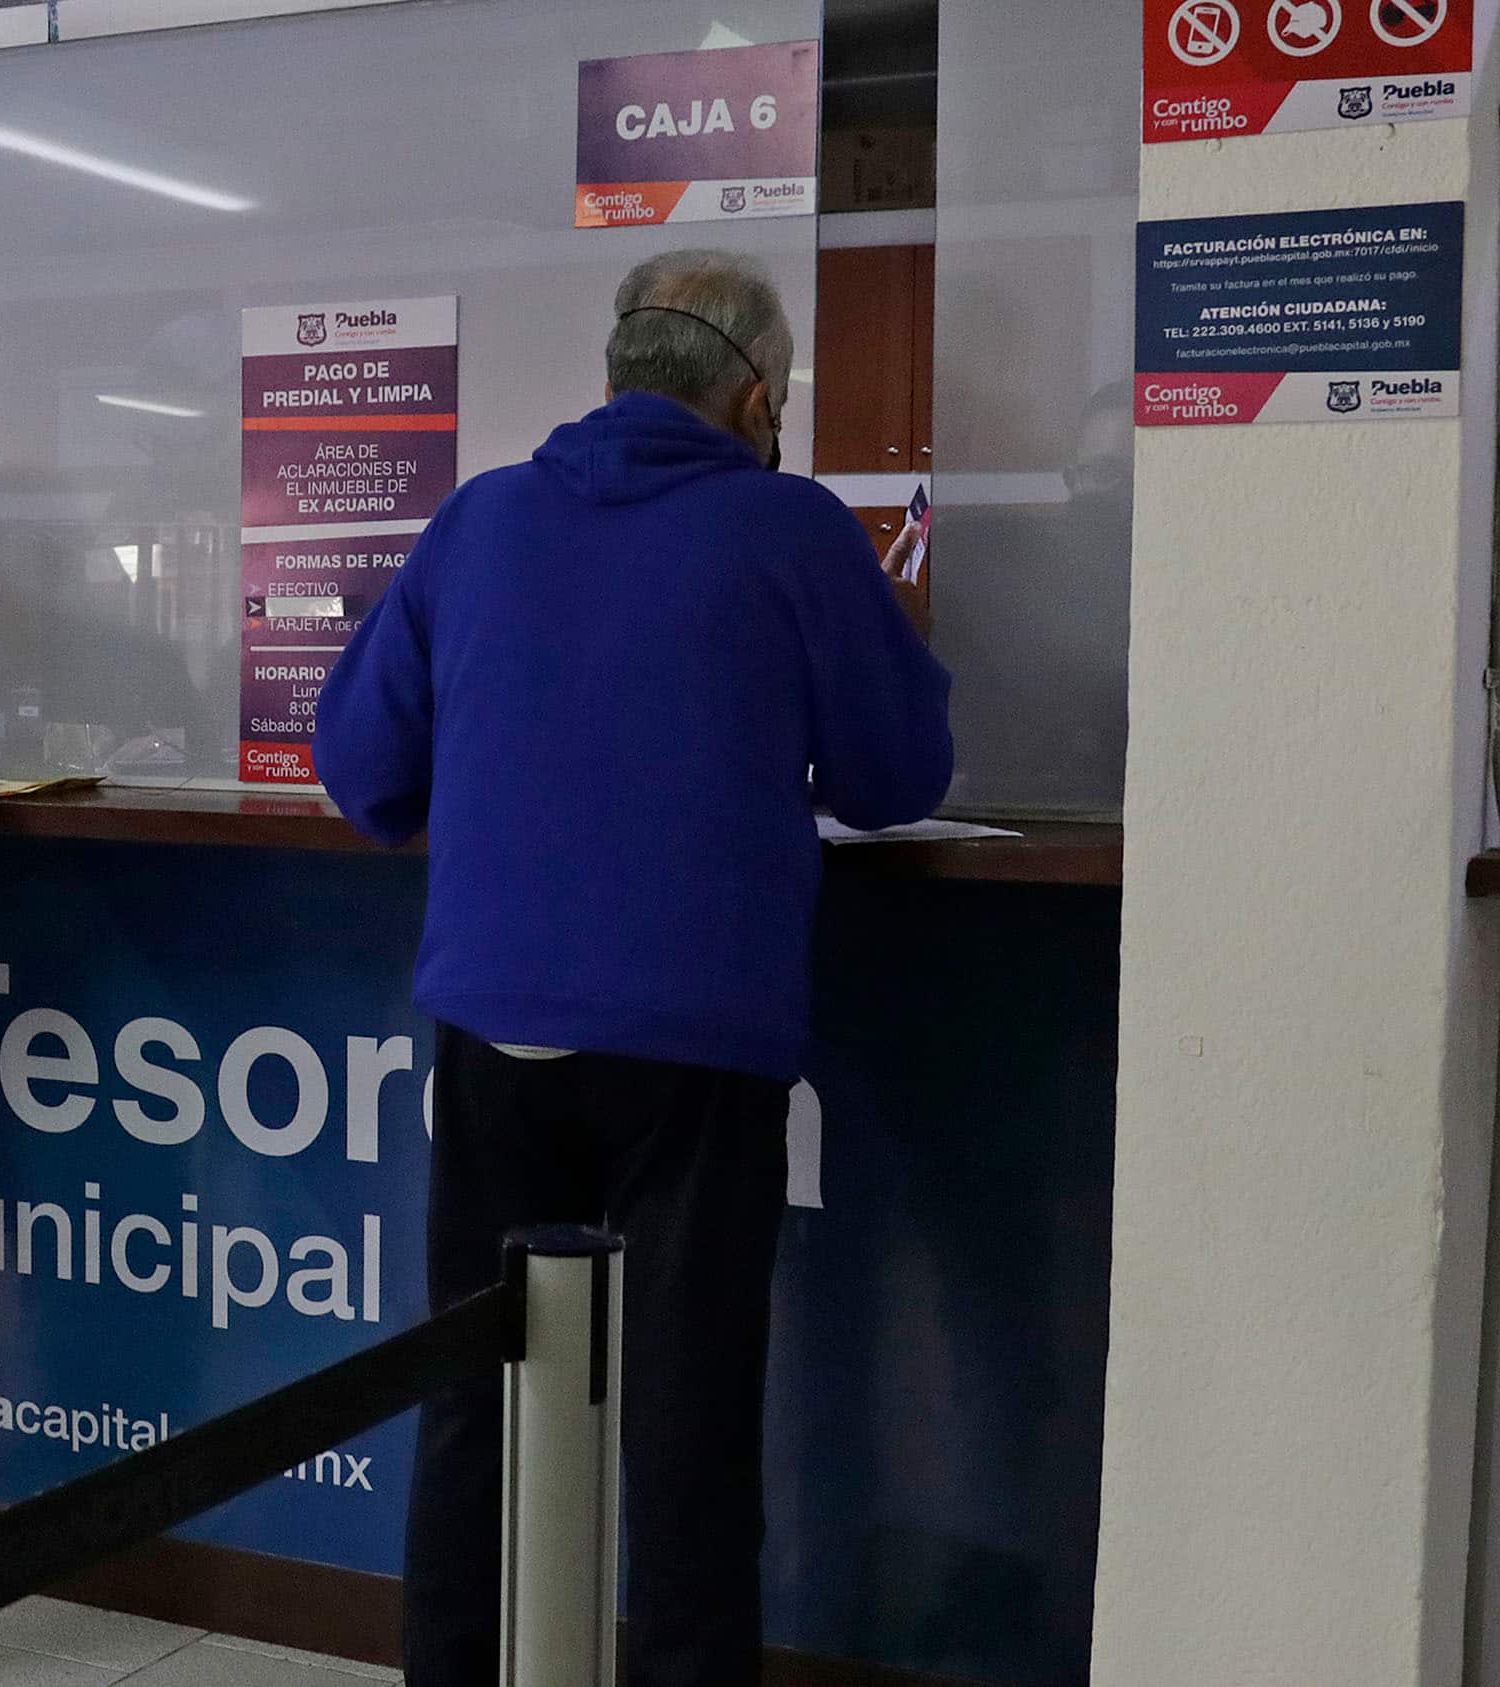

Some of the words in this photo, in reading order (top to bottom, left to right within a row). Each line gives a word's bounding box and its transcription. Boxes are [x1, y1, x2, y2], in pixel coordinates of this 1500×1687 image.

[1383, 80, 1455, 100] Puebla
[1153, 96, 1231, 118] Contigo
[616, 98, 735, 141] CAJA
[750, 95, 777, 129] 6
[1154, 120, 1160, 129] y
[1161, 118, 1178, 127] con
[1181, 112, 1248, 133] rumbo
[584, 191, 643, 209] Contigo
[753, 184, 805, 199] Puebla
[605, 204, 655, 220] rumbo
[1163, 234, 1276, 256] FACTURACIÓN
[1280, 228, 1395, 249] ELECTRÓNICA
[1400, 228, 1428, 241] EN:
[1209, 281, 1222, 290] su
[1224, 279, 1260, 290] factura
[1262, 278, 1275, 288] en
[1277, 277, 1287, 287] el
[1289, 276, 1311, 285] mes
[1313, 276, 1334, 287] que
[1336, 272, 1372, 283] realizó
[1373, 273, 1386, 281] su
[1200, 301, 1280, 320] ATENCIÓN
[1284, 299, 1387, 315] CIUDADANA:
[336, 310, 397, 328] Puebla
[1163, 327, 1189, 339] TEL:
[1192, 322, 1281, 337] 222.309.4600
[1283, 321, 1311, 333] EXT.
[1313, 319, 1345, 331] 5141,
[1348, 317, 1380, 330] 5136
[1382, 319, 1390, 330] y
[1393, 315, 1426, 327] 5190
[304, 363, 357, 382] PAGO
[363, 361, 390, 378] DE
[262, 389, 343, 408] PREDIAL
[349, 387, 362, 404] Y
[367, 384, 433, 404] LIMPIA
[1145, 383, 1221, 405] Contigo
[1371, 378, 1442, 396] Puebla
[1145, 405, 1151, 414] y
[1152, 404, 1169, 412] con
[1172, 400, 1238, 418] rumbo
[315, 442, 355, 460] ÁREA
[359, 444, 379, 458] DE
[277, 462, 393, 479] ACLARACIONES
[397, 461, 417, 475] EN
[286, 481, 303, 496] EL
[308, 480, 383, 496] INMUEBLE
[388, 478, 408, 493] DE
[298, 498, 319, 513] EX
[324, 497, 396, 513] ACUARIO
[276, 553, 341, 570] FORMAS
[346, 554, 368, 569] DE
[373, 552, 409, 568] PAG
[268, 582, 339, 596] EFECTIVO
[268, 617, 332, 632] TARJETA
[335, 621, 353, 634] (DE
[255, 666, 326, 682] HORARIO
[289, 701, 317, 716] 8:00
[251, 718, 303, 733] Sábado
[306, 718, 316, 733] d
[247, 749, 300, 767] Contigo
[265, 764, 311, 778] rumbo
